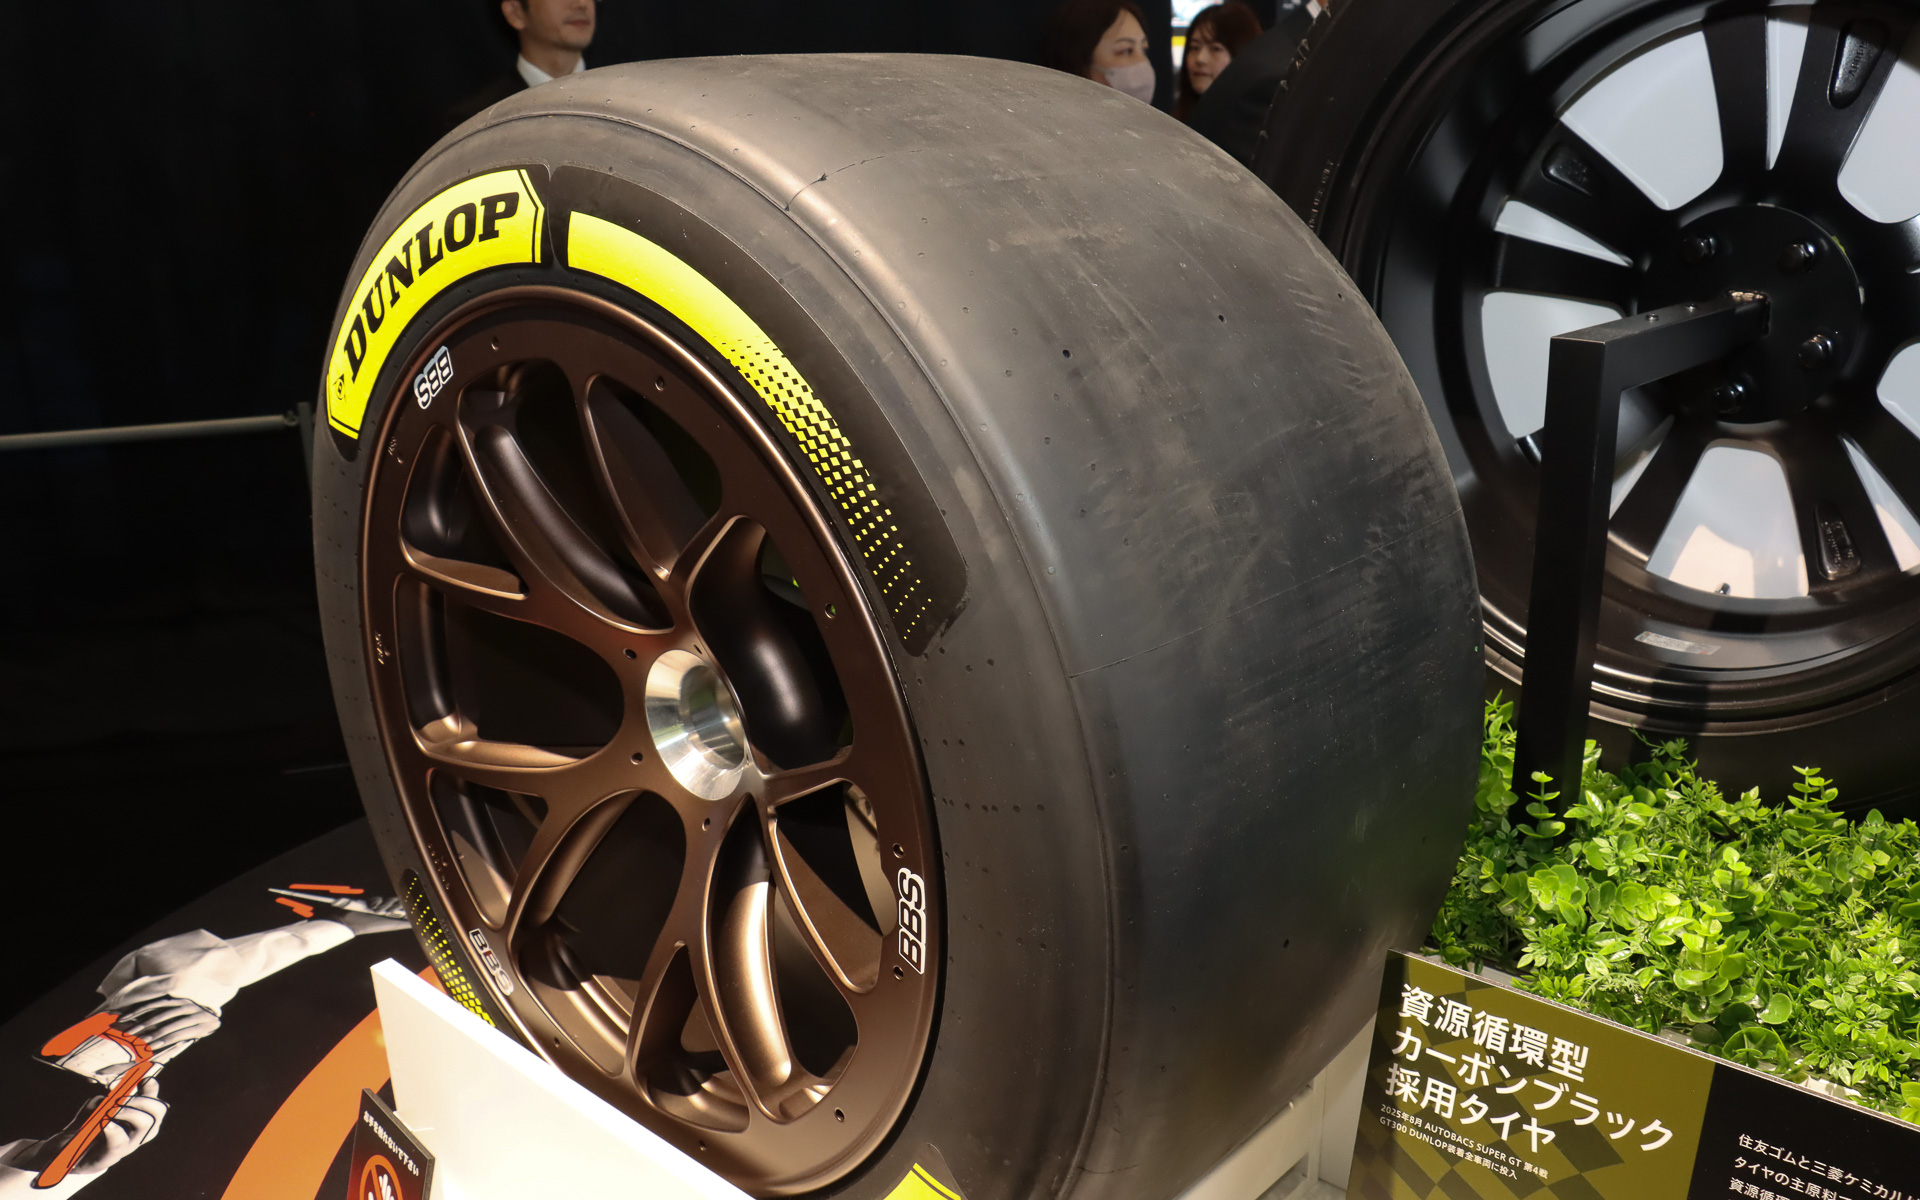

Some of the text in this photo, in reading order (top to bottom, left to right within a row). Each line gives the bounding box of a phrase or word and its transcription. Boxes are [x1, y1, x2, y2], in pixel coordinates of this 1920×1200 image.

[343, 191, 520, 384] DUNLOP
[413, 346, 454, 410] BBS
[898, 867, 926, 975] BBS
[469, 927, 514, 996] BBS
[1398, 983, 1589, 1083] 資源循環型
[1379, 1116, 1408, 1134] GT300
[1385, 1062, 1556, 1153] 採用タイヤ
[1391, 1026, 1674, 1152] カーボンブラック
[1380, 1103, 1549, 1180] 2025年8月 AUTOBACS SUPER GT 第4戦
[1734, 1156, 1852, 1200] タイヤの主原料
[1738, 1133, 1920, 1200] 住友ゴムと三菱ケミカル
